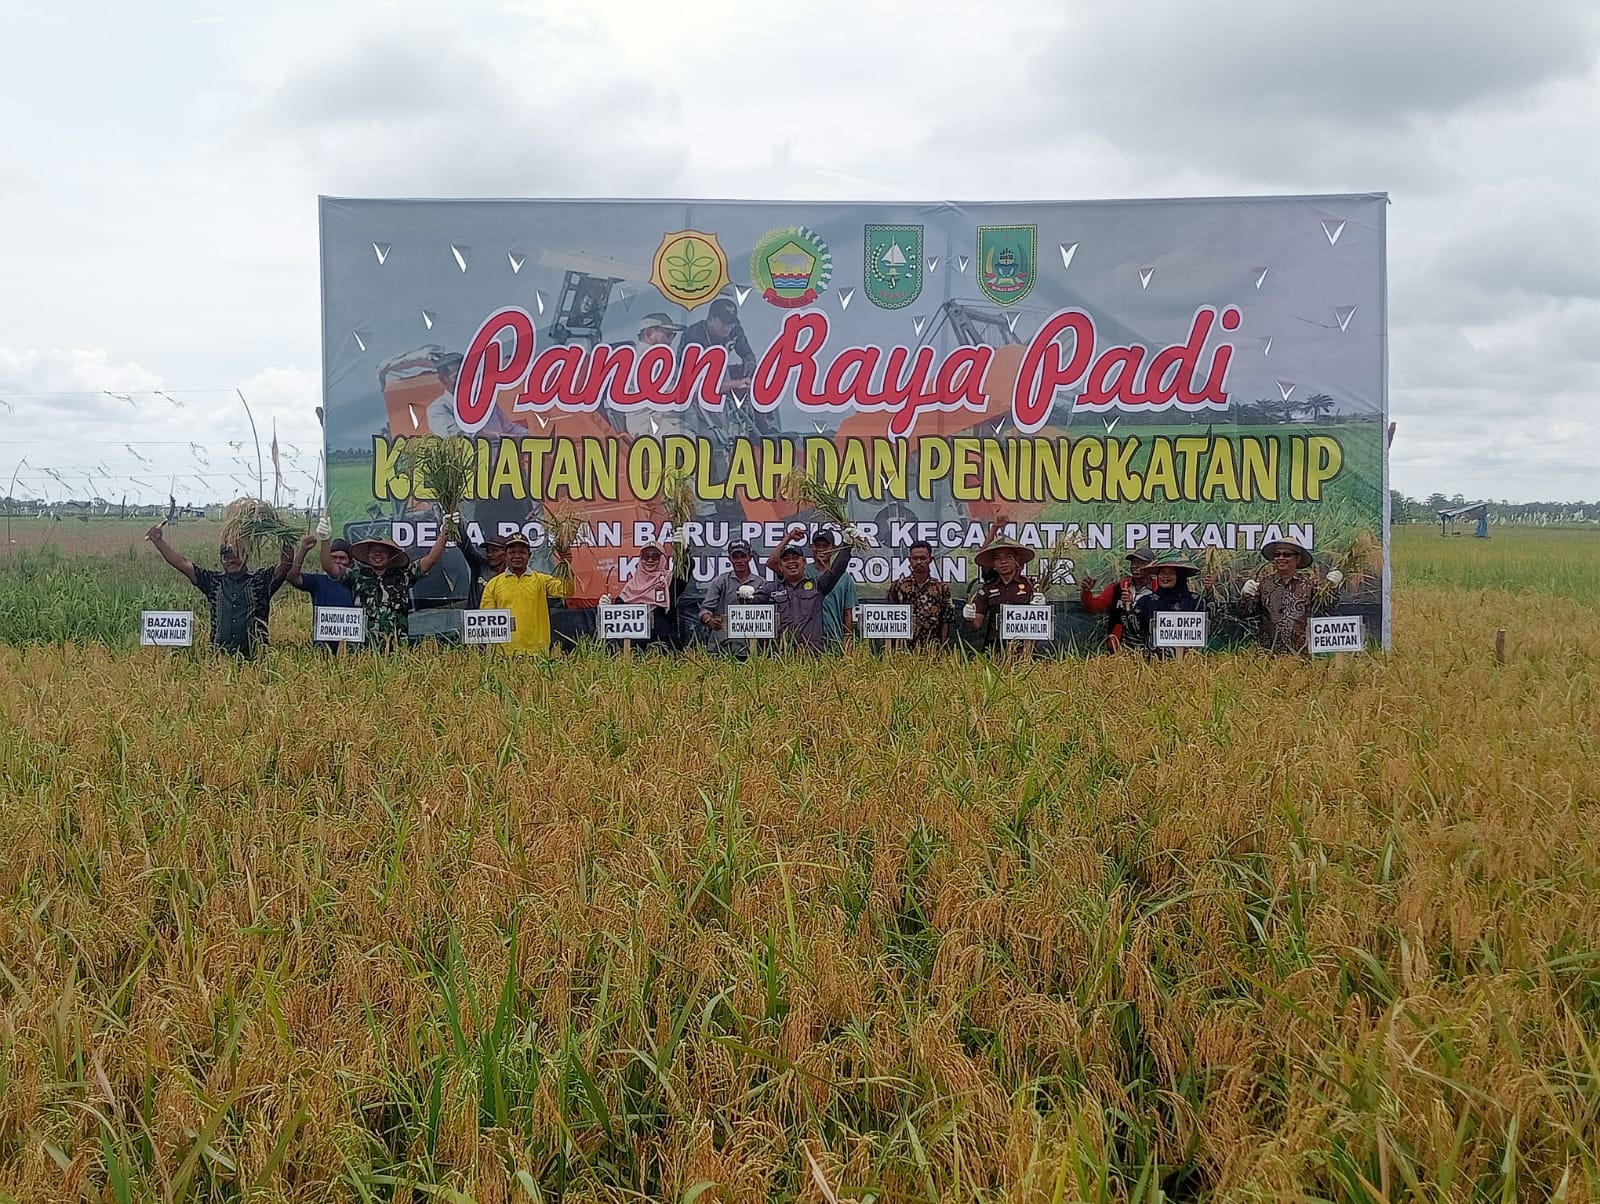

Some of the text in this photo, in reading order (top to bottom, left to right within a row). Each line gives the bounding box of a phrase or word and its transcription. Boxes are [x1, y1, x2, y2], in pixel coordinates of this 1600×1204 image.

[454, 303, 1243, 442] Panen Raya Padi
[628, 435, 796, 501] OPLAH
[803, 436, 908, 501] DAN
[916, 435, 1281, 502] PENINGKATAN
[1285, 435, 1345, 501] IP
[391, 521, 486, 547] DEA
[497, 521, 621, 548] ROAN
[633, 521, 731, 548] BARU
[741, 521, 880, 548] PESISR
[1125, 523, 1315, 550] PEKAITAN
[320, 613, 361, 624] DANDIM 0321
[604, 610, 645, 620] BPSIP
[745, 610, 772, 620] BUPATI
[866, 610, 908, 621] POLRES
[1006, 610, 1049, 621] KaJARI
[147, 617, 187, 628] BAZNAS
[467, 615, 508, 627] DPRD
[1159, 617, 1202, 628] Ka. DKPP
[320, 625, 360, 637] ROKAN HILIR
[467, 628, 508, 638] ROKAN HILIR
[604, 623, 645, 633] RIAU
[731, 623, 772, 633] ROKAN HILIR
[866, 623, 907, 633] ROKAN HILIR
[1006, 623, 1048, 634] ROKAN HILIR
[1314, 622, 1357, 635] CAMAT
[146, 629, 187, 640] ROKAN HILIR
[1159, 630, 1183, 640] ROKAN
[1314, 634, 1358, 647] PEKAITAN
